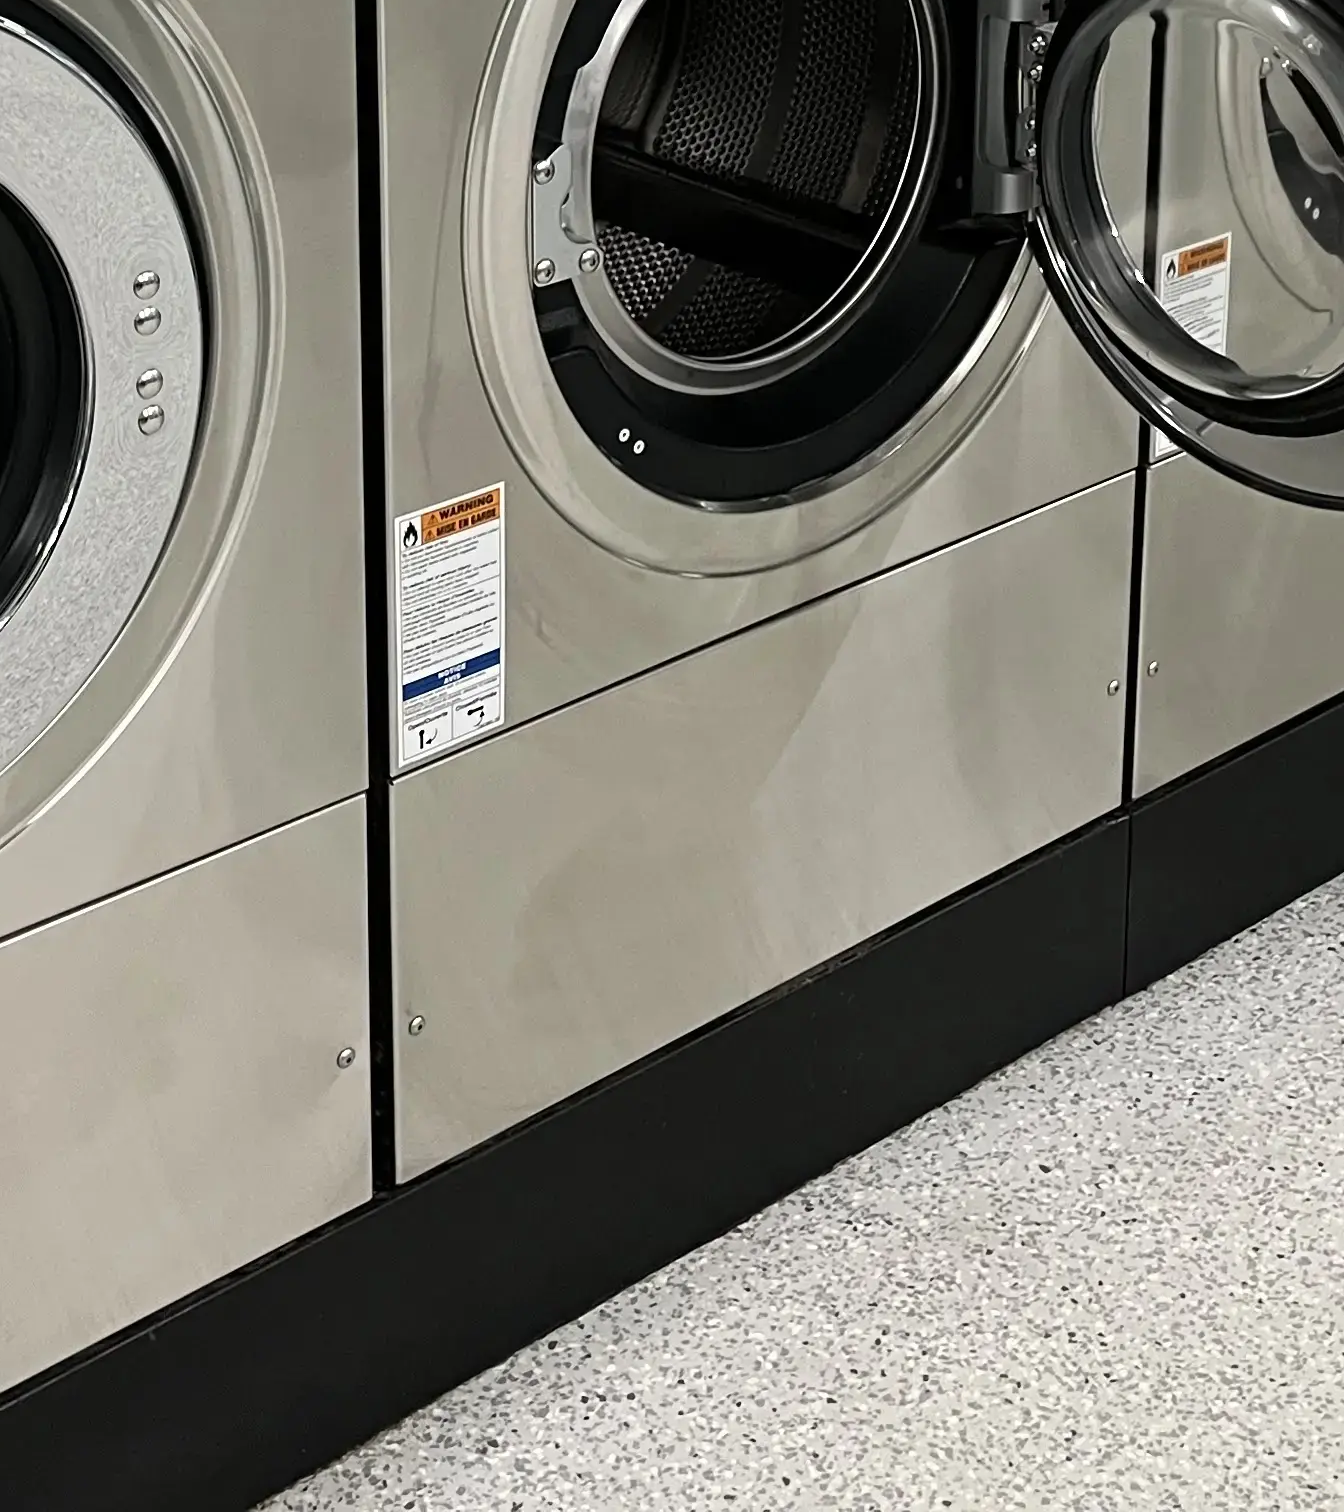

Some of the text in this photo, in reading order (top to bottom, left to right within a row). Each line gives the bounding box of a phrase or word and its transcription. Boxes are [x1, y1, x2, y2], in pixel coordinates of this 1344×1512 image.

[438, 494, 494, 520] WARNING
[436, 507, 496, 536] MISE EN GARDE
[437, 662, 467, 679] NOTICE
